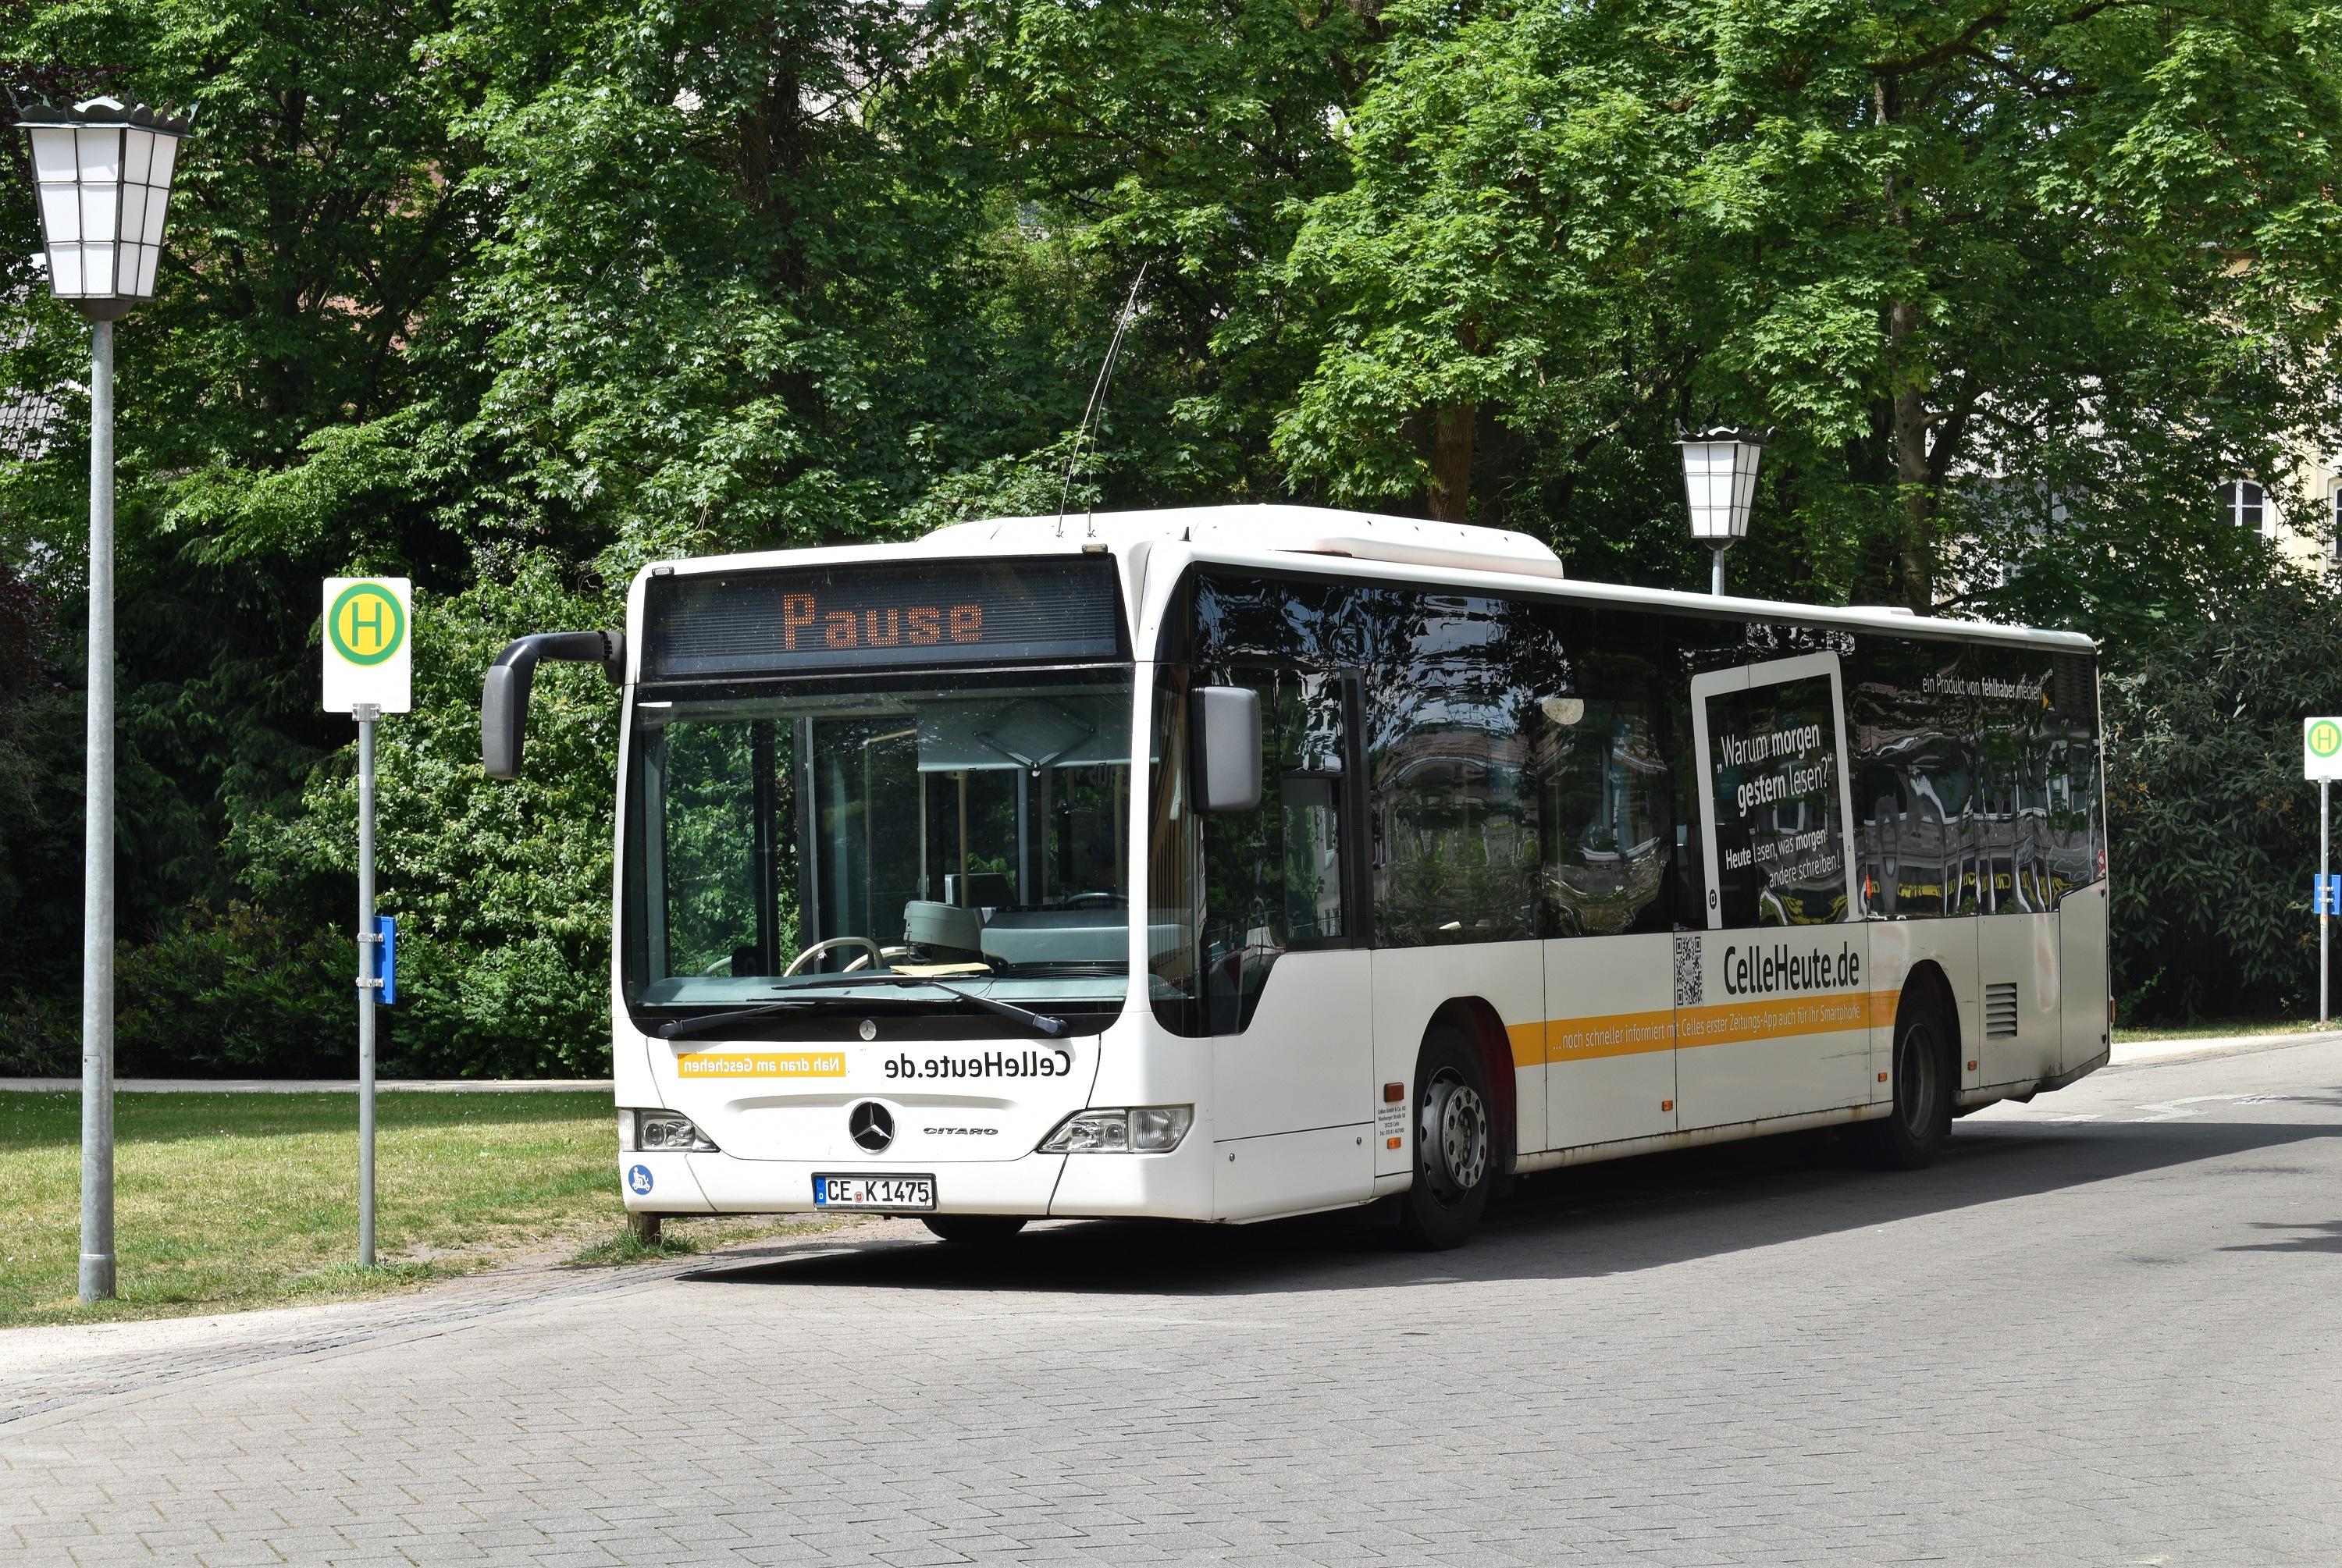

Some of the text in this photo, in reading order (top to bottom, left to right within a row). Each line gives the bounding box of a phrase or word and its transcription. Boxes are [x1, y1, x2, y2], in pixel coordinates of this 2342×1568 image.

[352, 602, 382, 647] H
[784, 593, 982, 649] Pause
[1923, 673, 1934, 693] ein
[1936, 674, 1965, 695] Produkt
[1966, 681, 1981, 696] von
[1771, 724, 1820, 759] morgen
[2317, 728, 2331, 749] H
[1737, 774, 1785, 817] gestern
[1725, 828, 1826, 870] Heute lesen, was morgen
[1769, 865, 1796, 887] andere
[1724, 940, 1860, 995] CelleHeute.de
[1586, 1028, 1624, 1047] schneller
[1626, 1025, 1665, 1043] informiert
[1682, 1019, 1704, 1036] Celles
[1707, 1017, 1728, 1033] erster
[1729, 1011, 1777, 1033] Zeitungs-App
[1779, 1008, 1796, 1026] auch
[1797, 1006, 1807, 1024] für
[1809, 1005, 1818, 1022] Ihr
[1820, 1004, 1860, 1024] Smartphone
[923, 1127, 998, 1136] CITARO
[828, 1180, 852, 1201] CE
[865, 1181, 877, 1201] K
[882, 1181, 929, 1202] 1475
